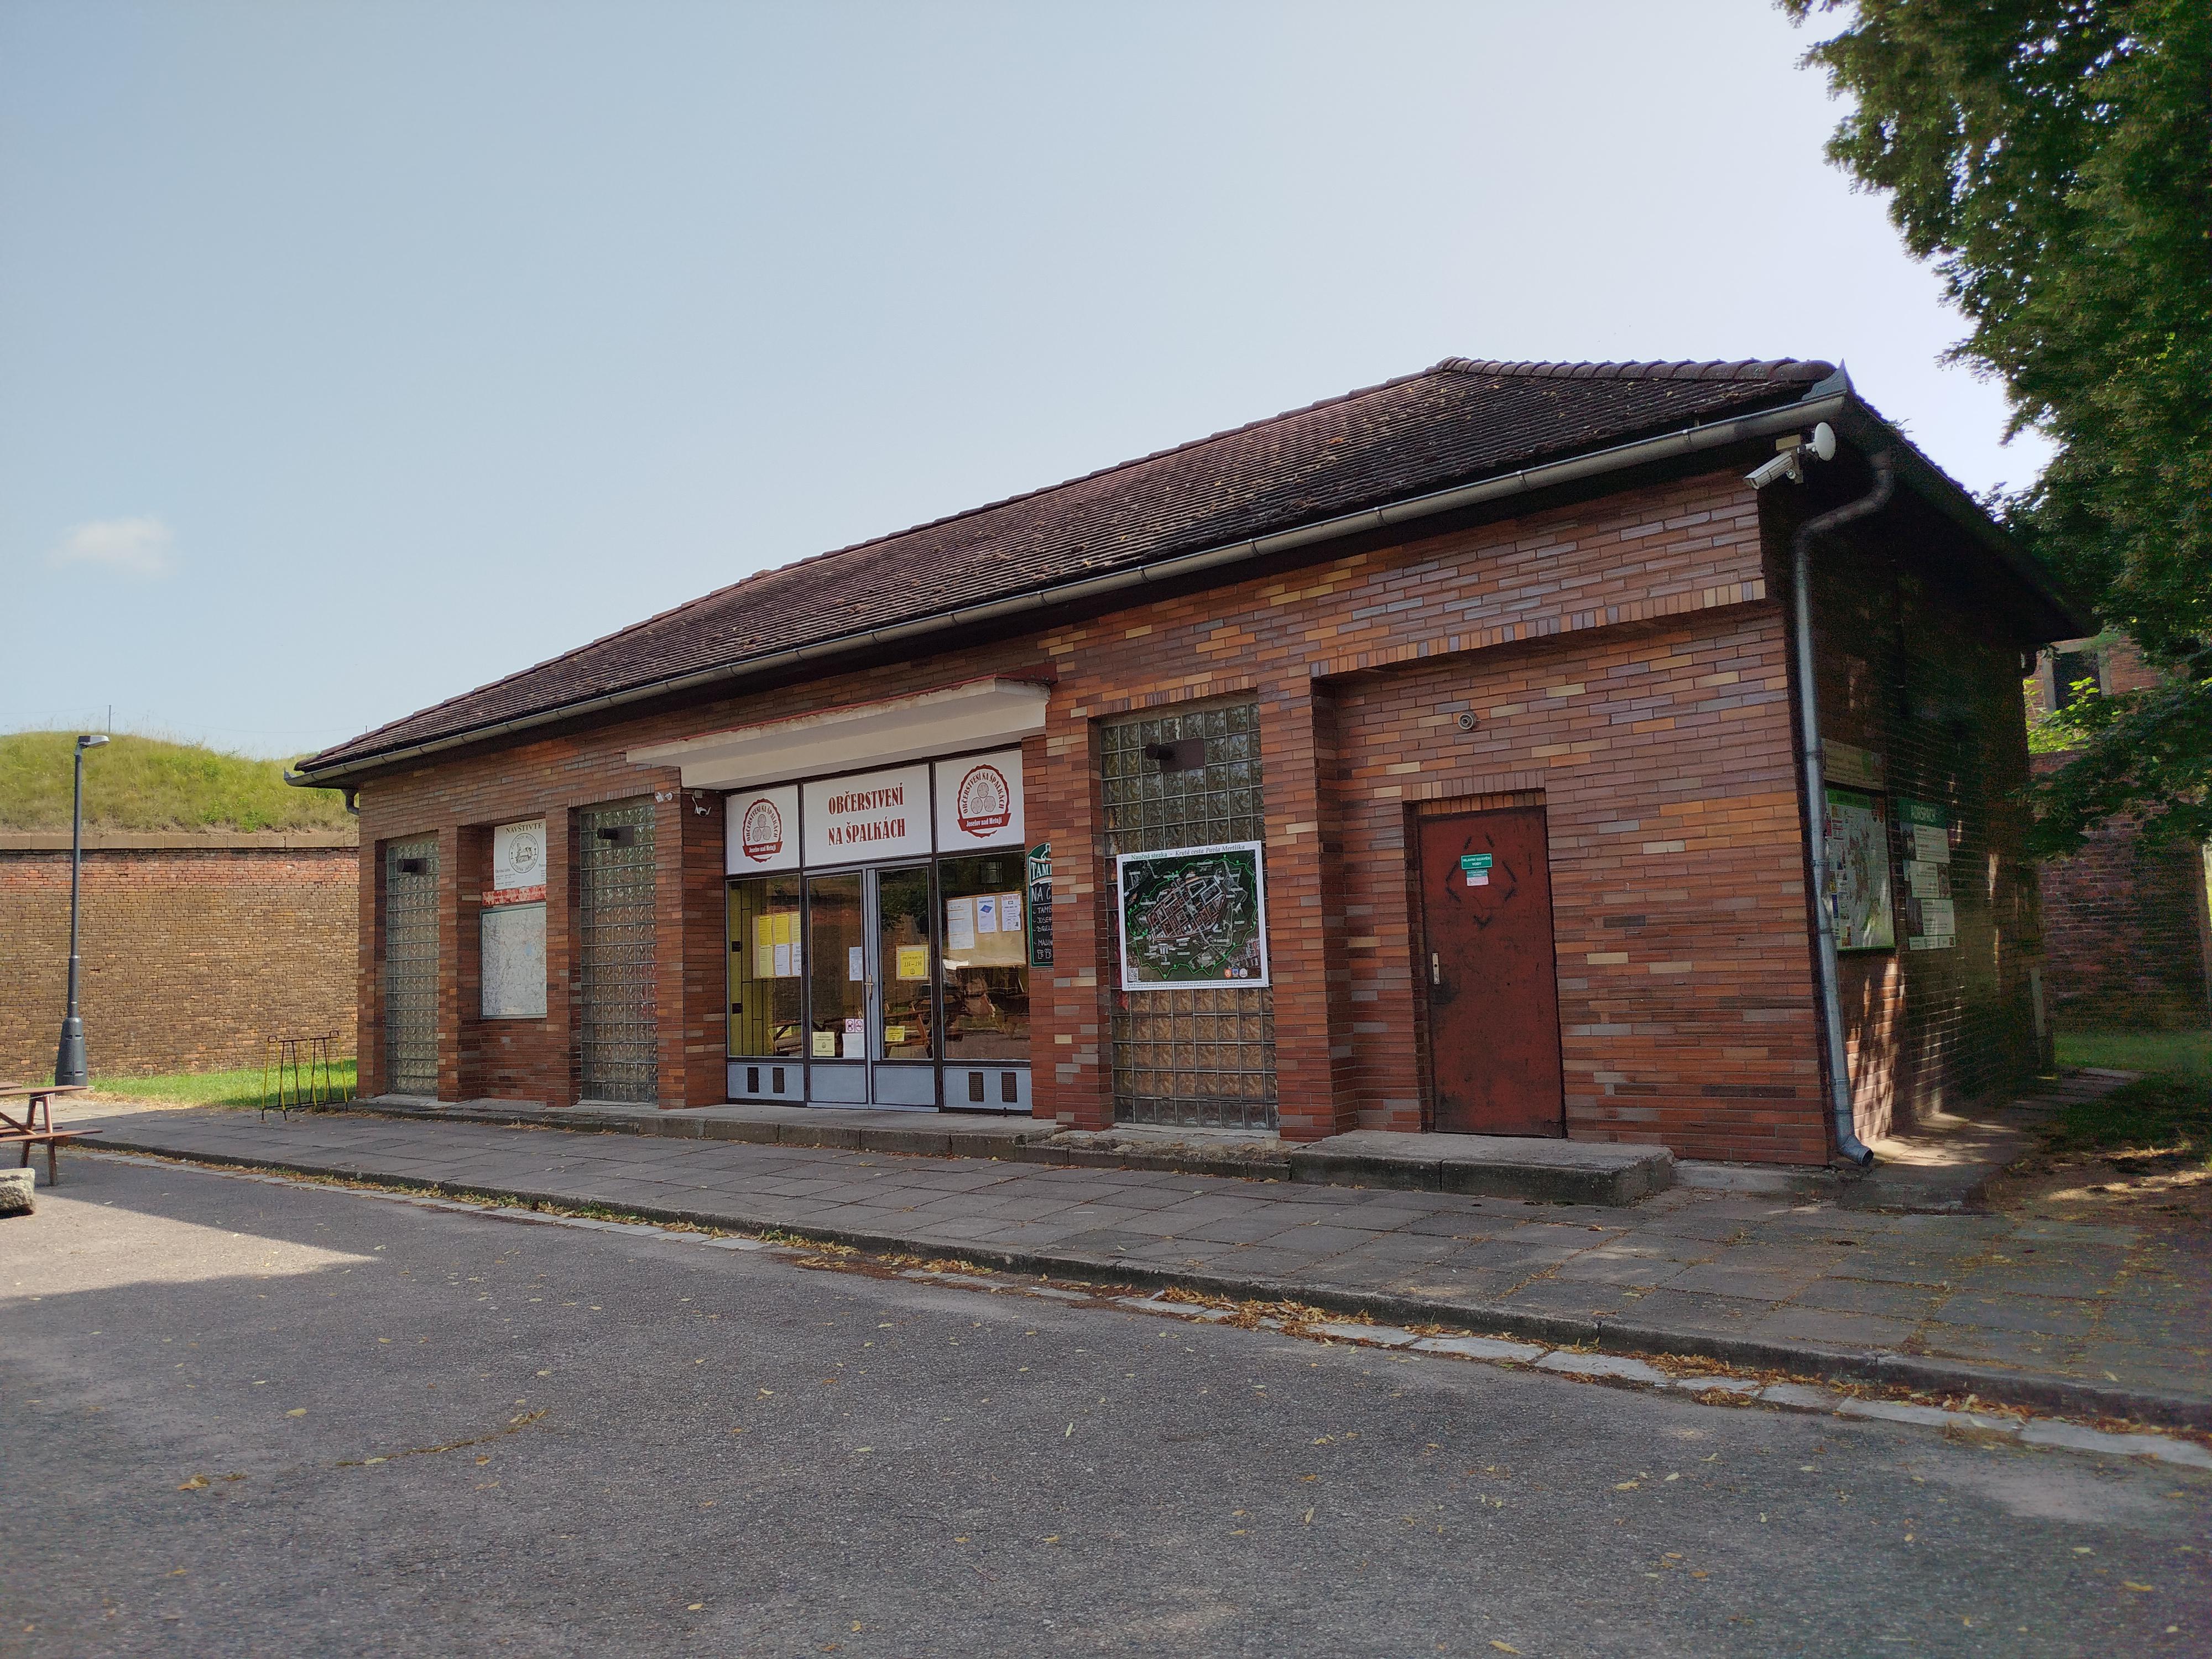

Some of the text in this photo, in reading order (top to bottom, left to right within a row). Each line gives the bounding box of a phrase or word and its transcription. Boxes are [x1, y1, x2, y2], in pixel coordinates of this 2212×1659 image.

[828, 782, 904, 815] OBČERSTVENÍ
[962, 771, 981, 814] OBČERSTVENÍ
[982, 772, 989, 780] NA
[506, 822, 542, 834] NAVŠTIVTE
[828, 816, 905, 846] NA ŠPALKÁCH
[1031, 886, 1044, 902] NA
